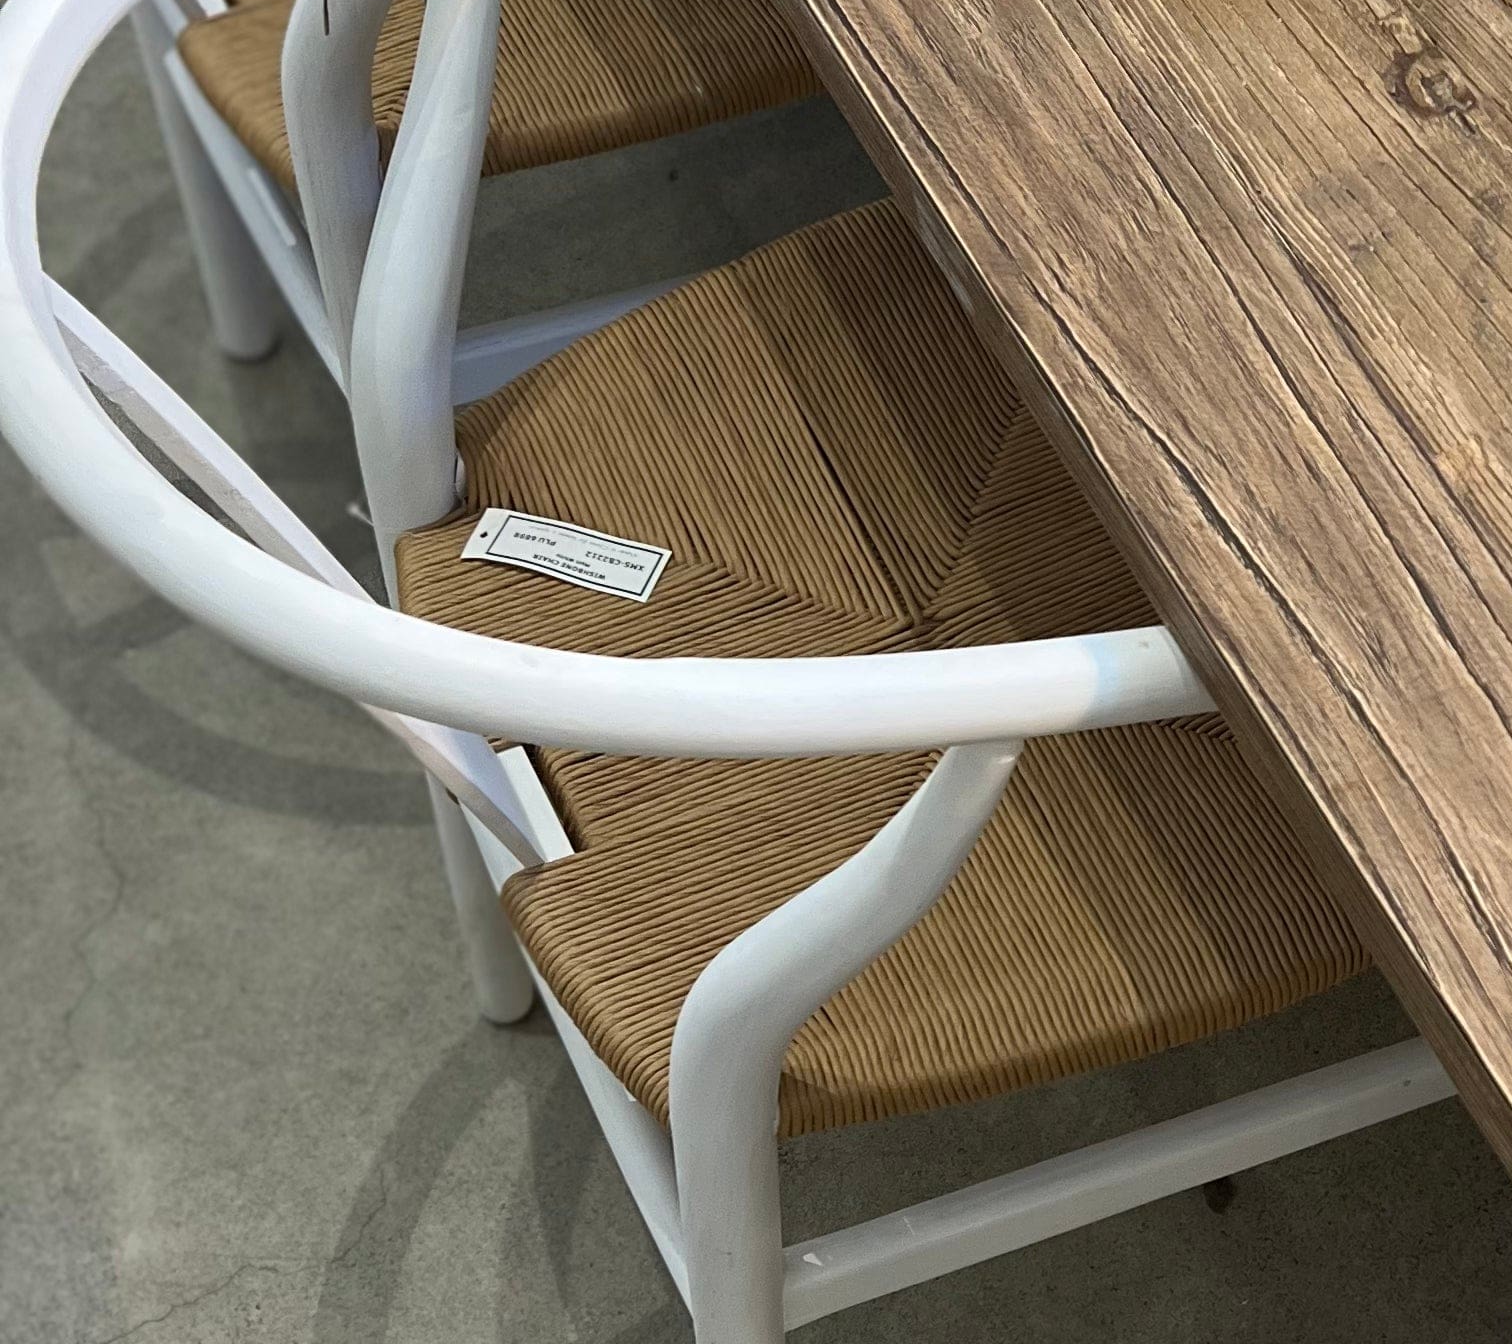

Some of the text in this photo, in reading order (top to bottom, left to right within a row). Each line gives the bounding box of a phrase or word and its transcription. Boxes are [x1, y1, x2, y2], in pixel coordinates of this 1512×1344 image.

[538, 537, 557, 547] PLU
[532, 553, 606, 580] WISHBONE CHAIR
